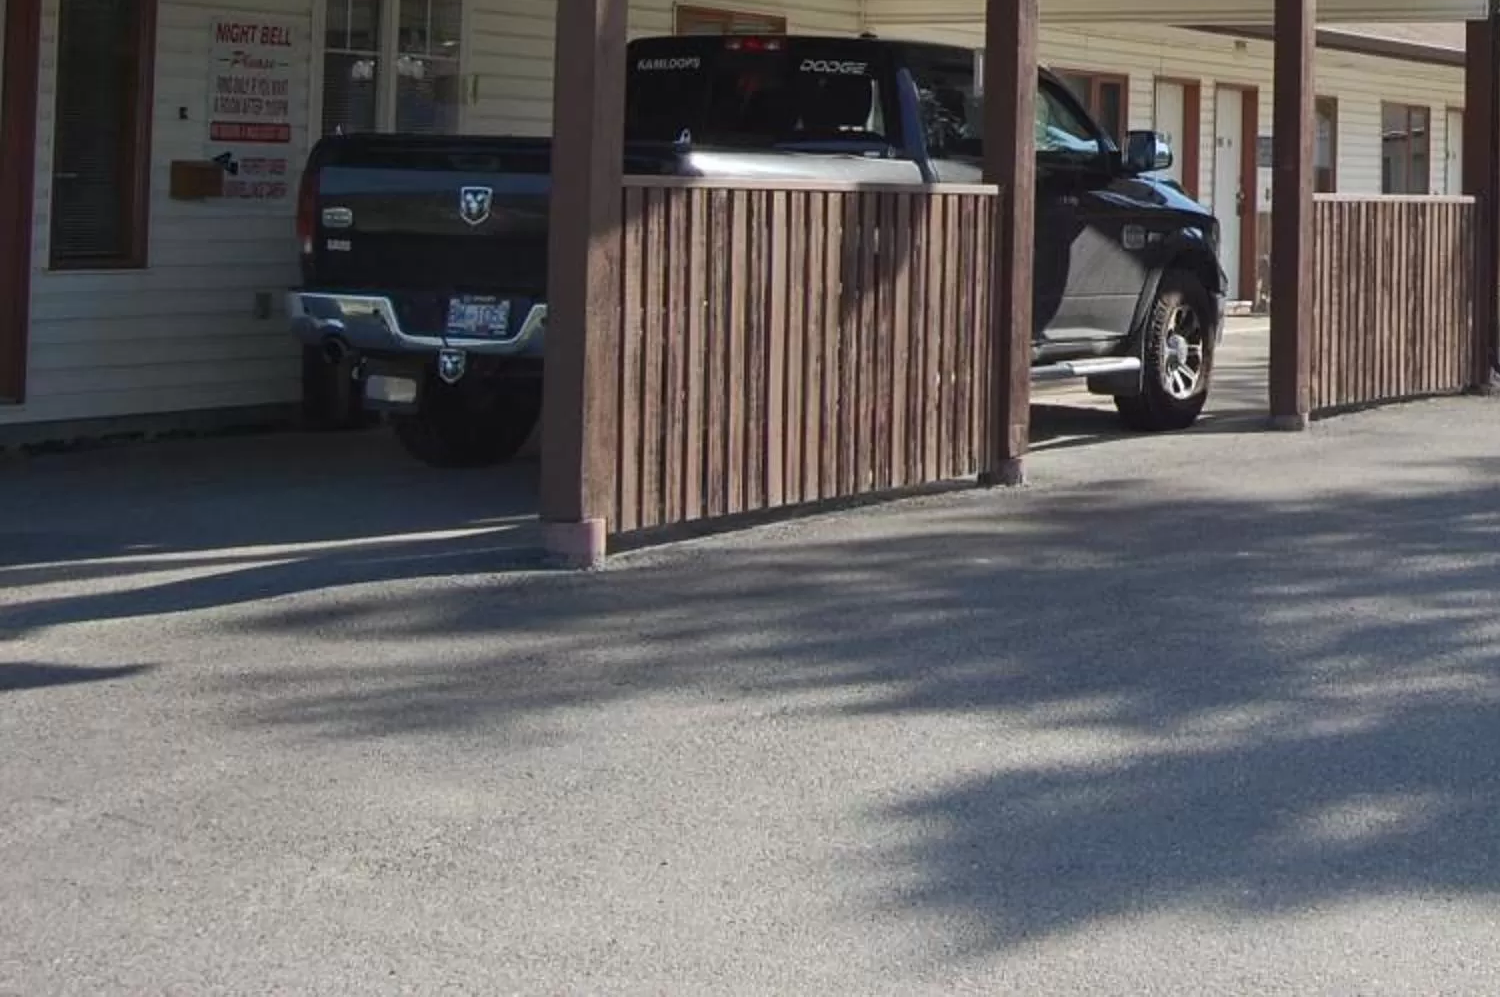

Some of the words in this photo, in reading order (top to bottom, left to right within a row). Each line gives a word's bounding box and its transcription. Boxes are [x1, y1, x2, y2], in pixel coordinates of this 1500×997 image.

[216, 23, 258, 43] NIGHT
[260, 26, 292, 47] BELL
[637, 57, 702, 72] KAMLOOPS
[800, 58, 868, 74] DODGE
